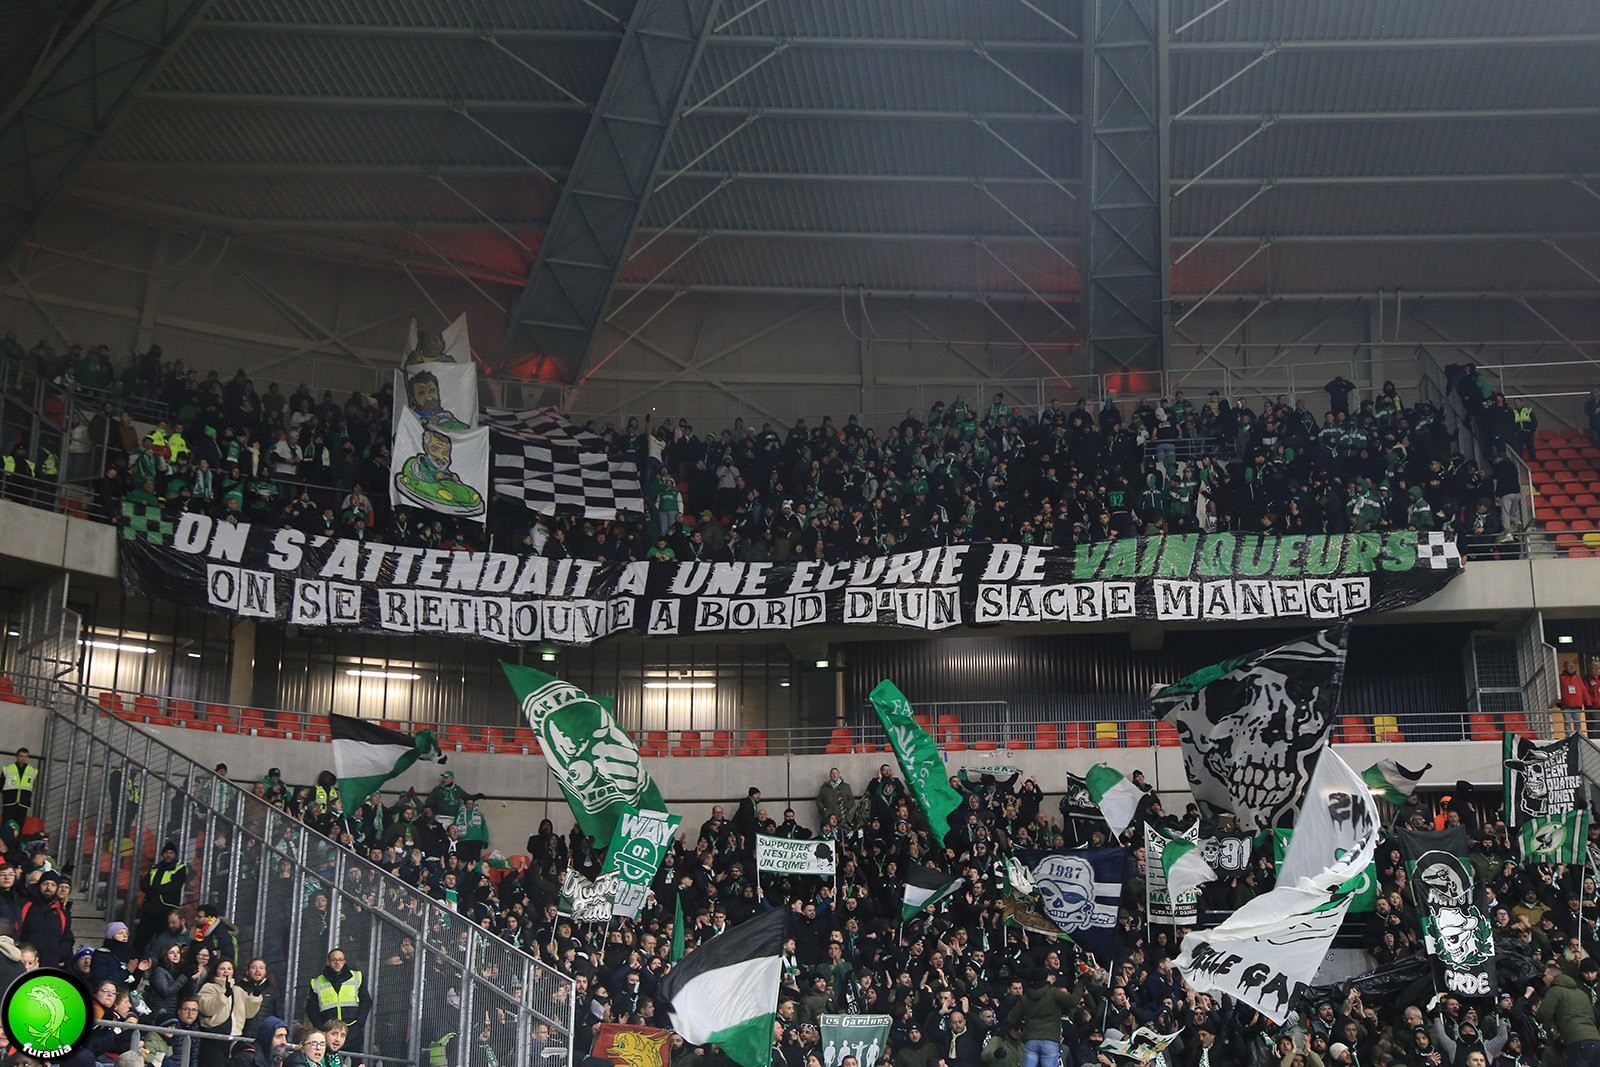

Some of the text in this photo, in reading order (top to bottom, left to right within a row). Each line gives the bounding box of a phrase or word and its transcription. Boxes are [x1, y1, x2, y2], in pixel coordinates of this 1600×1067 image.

[172, 512, 1420, 597] ON S'ATTENDAIT A UNE ECURIE DE VAINQUEURS
[211, 569, 1370, 638] ON SE RETROUVE A BORD D'UN SACRE MANEGE
[1545, 764, 1568, 779] CENT
[1548, 788, 1575, 804] VINGT
[621, 813, 679, 847] WAY
[632, 844, 651, 859] OF
[759, 838, 812, 852] SUPPORTER
[791, 851, 808, 861] PAS
[1219, 837, 1252, 871] 91
[759, 859, 774, 867] UN
[1048, 863, 1083, 880] 1987
[1149, 892, 1184, 903] MAGC
